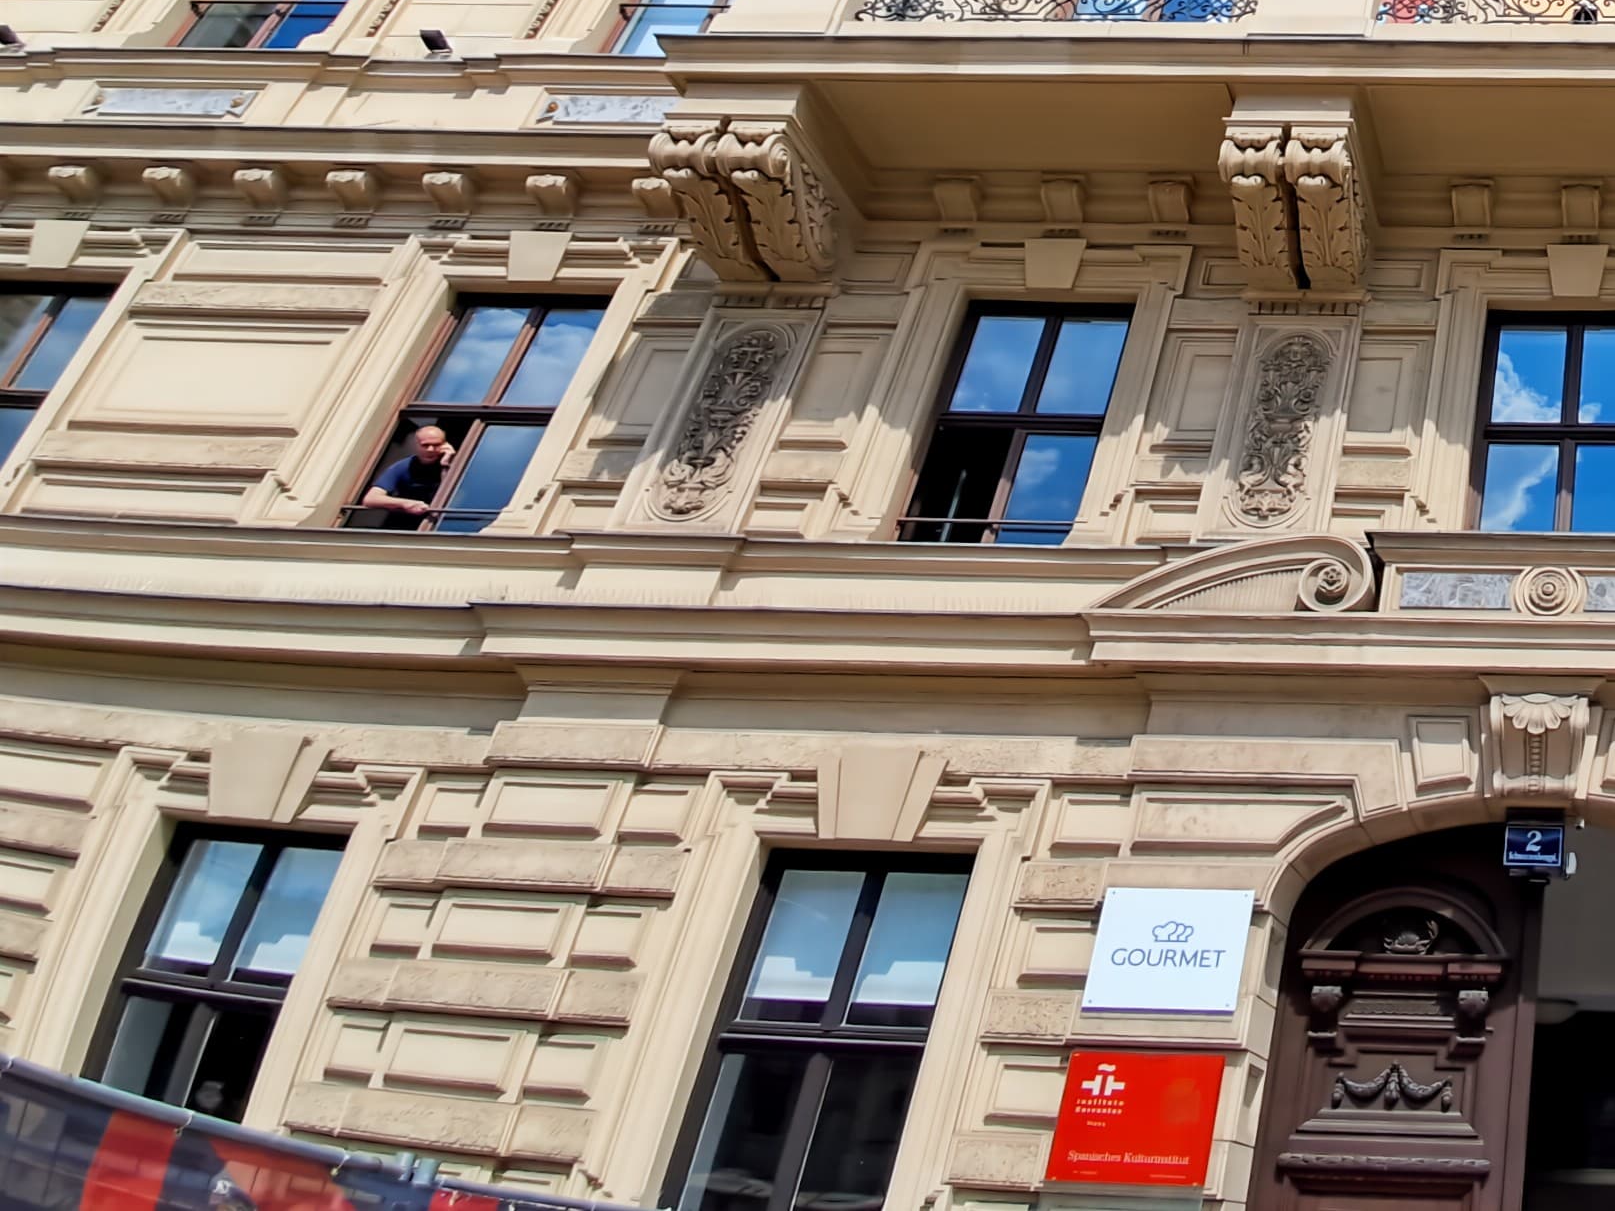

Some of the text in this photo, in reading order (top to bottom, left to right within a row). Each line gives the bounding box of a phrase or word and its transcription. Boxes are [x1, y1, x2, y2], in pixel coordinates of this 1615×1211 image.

[1525, 830, 1543, 852] 2
[1111, 948, 1226, 968] GOURMET
[1067, 1149, 1121, 1162] Spanisches
